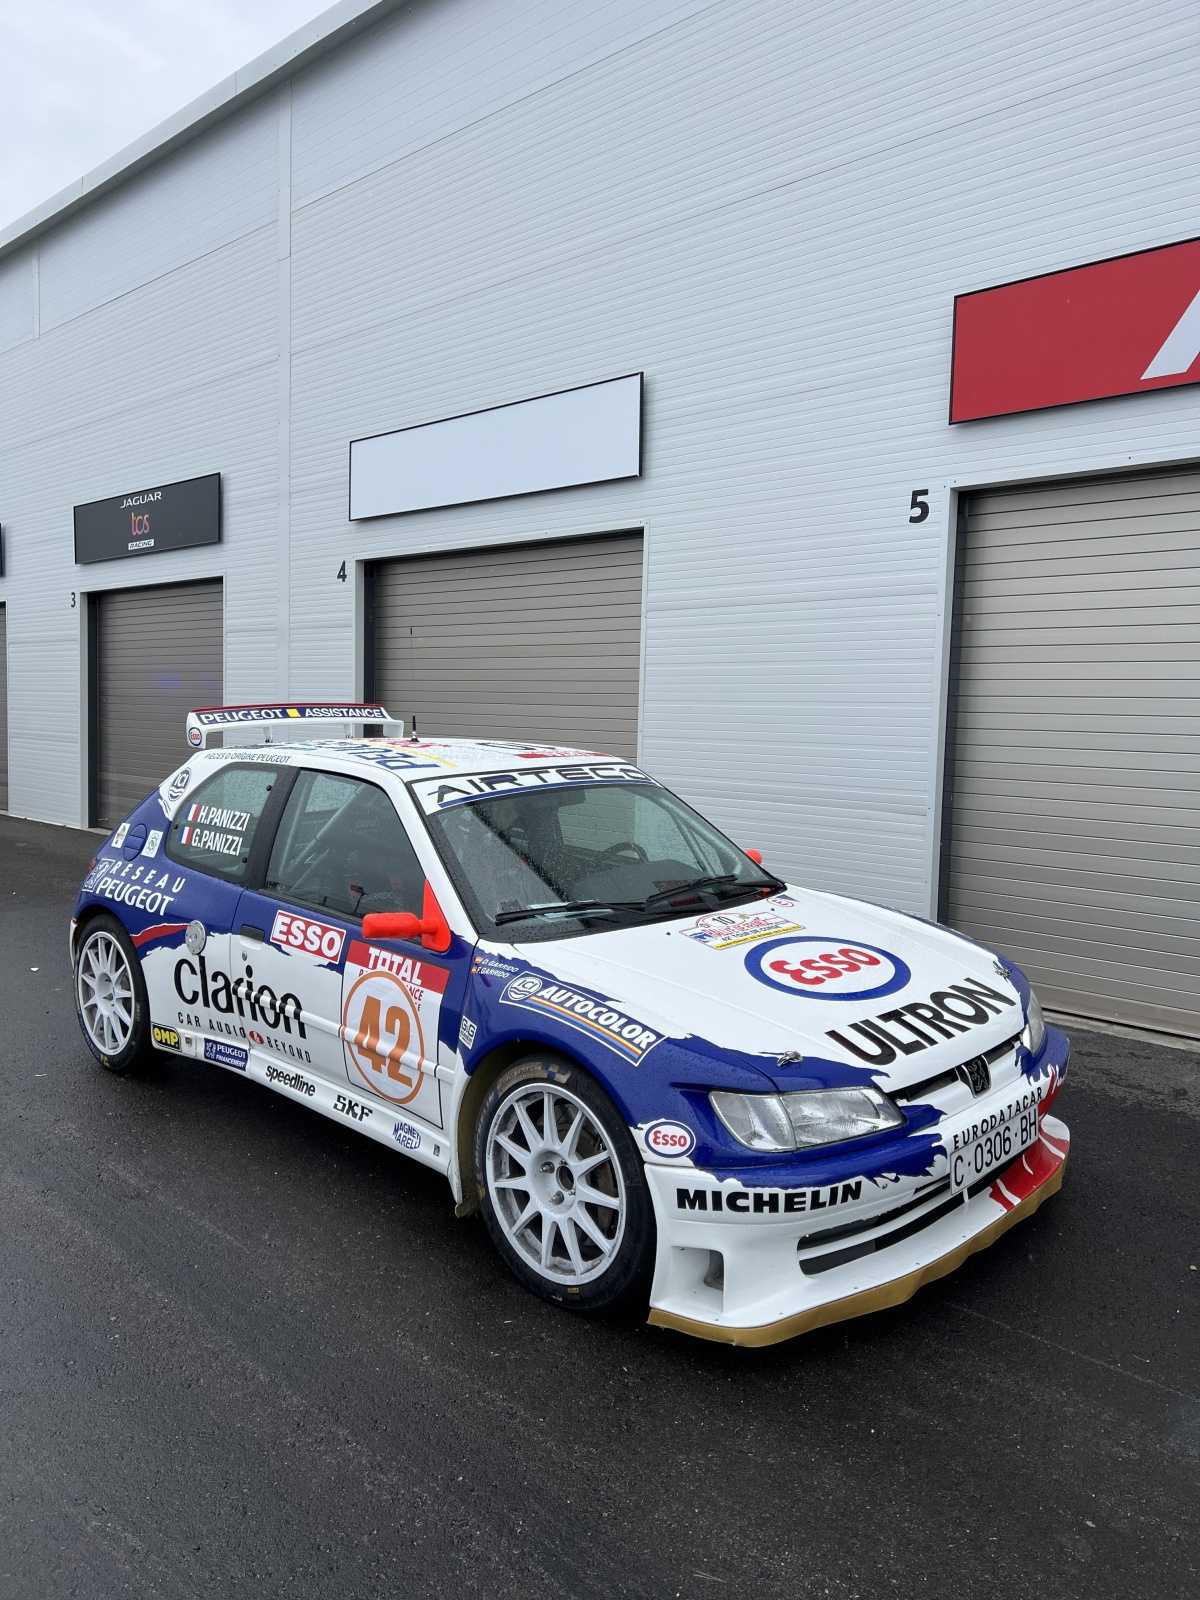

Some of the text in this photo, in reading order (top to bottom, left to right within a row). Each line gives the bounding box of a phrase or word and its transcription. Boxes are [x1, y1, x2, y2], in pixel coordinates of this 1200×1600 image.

[120, 491, 162, 508] JAGUAR
[909, 488, 929, 523] 5
[336, 560, 347, 582] 4
[70, 591, 76, 608] 3
[202, 707, 382, 724] PEUGEOT ASSISTANCE
[110, 860, 186, 893] RESEAU
[96, 877, 175, 916] PEUGEOT
[272, 914, 343, 958] ESSO
[367, 947, 422, 986] TOTAL
[516, 979, 538, 989] ICI
[535, 985, 657, 1049] AUTOCOLOR
[824, 977, 1017, 1066] ULTRON
[152, 1027, 179, 1046] OMP
[178, 1011, 201, 1028] CAR
[209, 1018, 247, 1039] AUDIO
[267, 1035, 312, 1064] BEYOND
[217, 1044, 247, 1059] PEUGEOT
[354, 995, 413, 1088] 42
[265, 1065, 316, 1097] speedline
[333, 1094, 373, 1121] SKF
[953, 1087, 1042, 1150] EURODATACAR
[676, 1180, 863, 1214] MICHELIN
